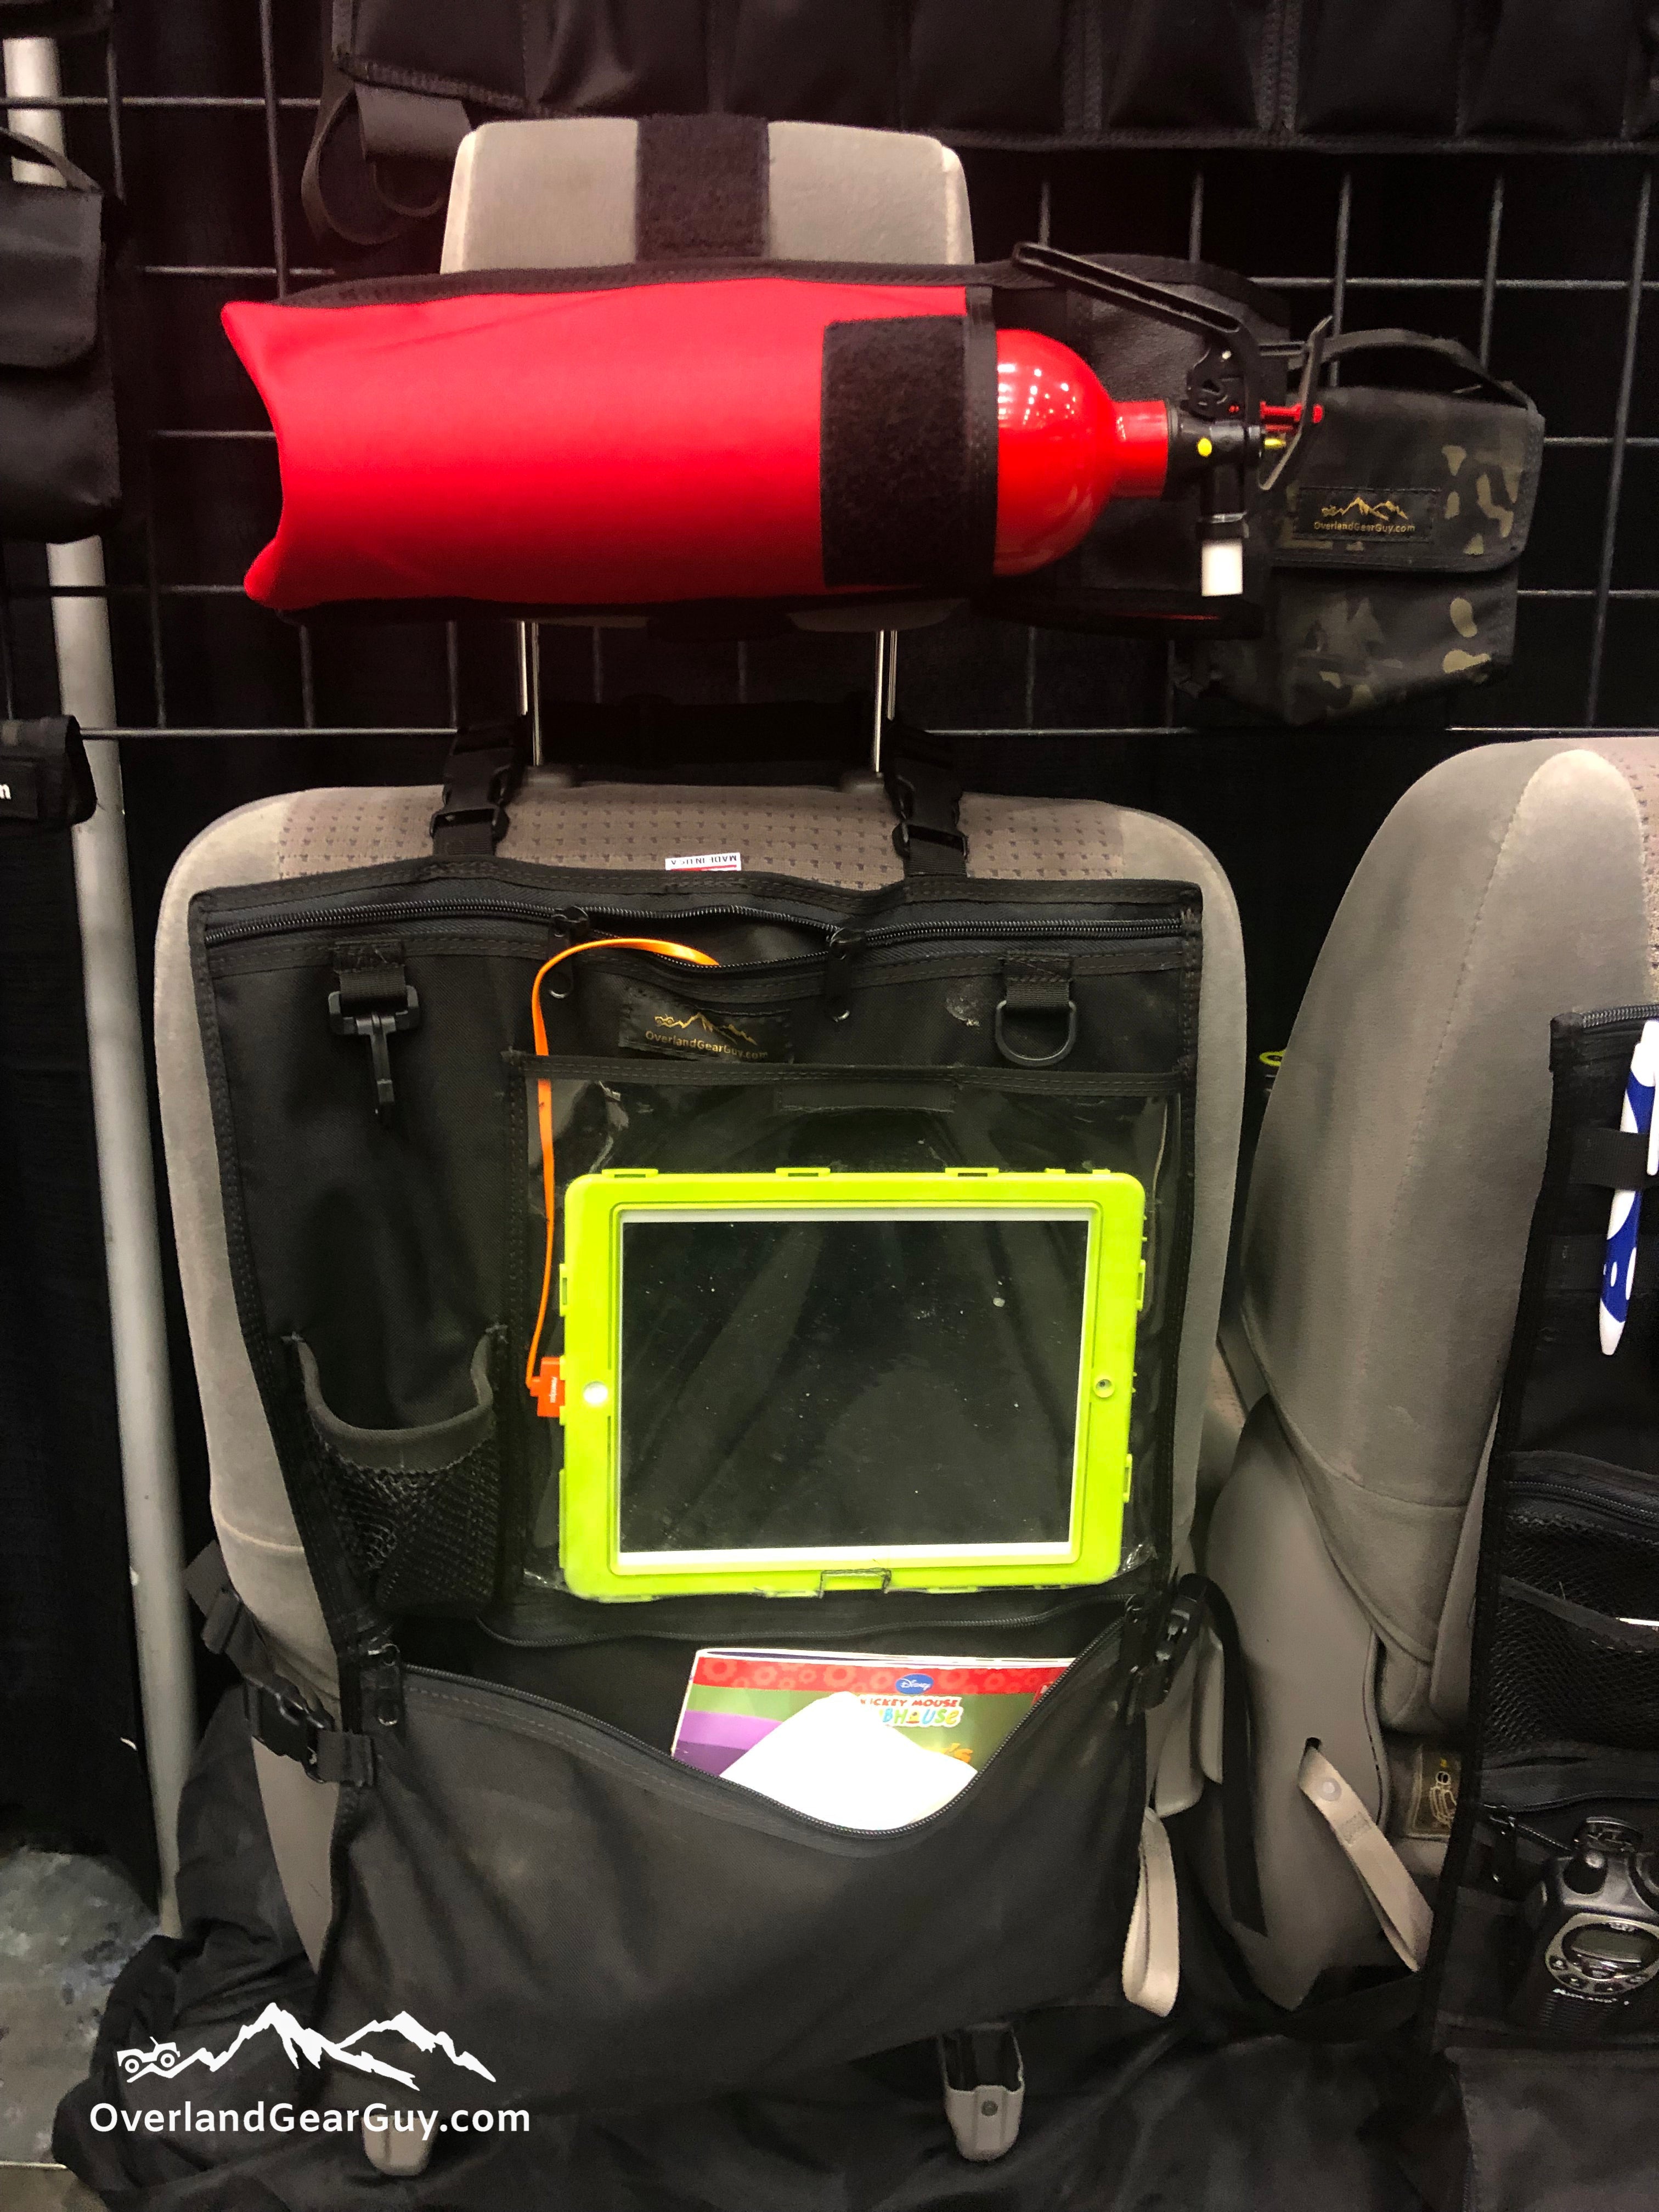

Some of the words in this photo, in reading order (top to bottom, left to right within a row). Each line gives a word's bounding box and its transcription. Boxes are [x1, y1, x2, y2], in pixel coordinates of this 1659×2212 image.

[1314, 522, 1415, 534] OverlandGearGuy.com
[646, 1031, 768, 1059] OverlandGearGuy.com
[900, 1678, 931, 1690] Disney
[911, 1699, 958, 1707] MOUSE
